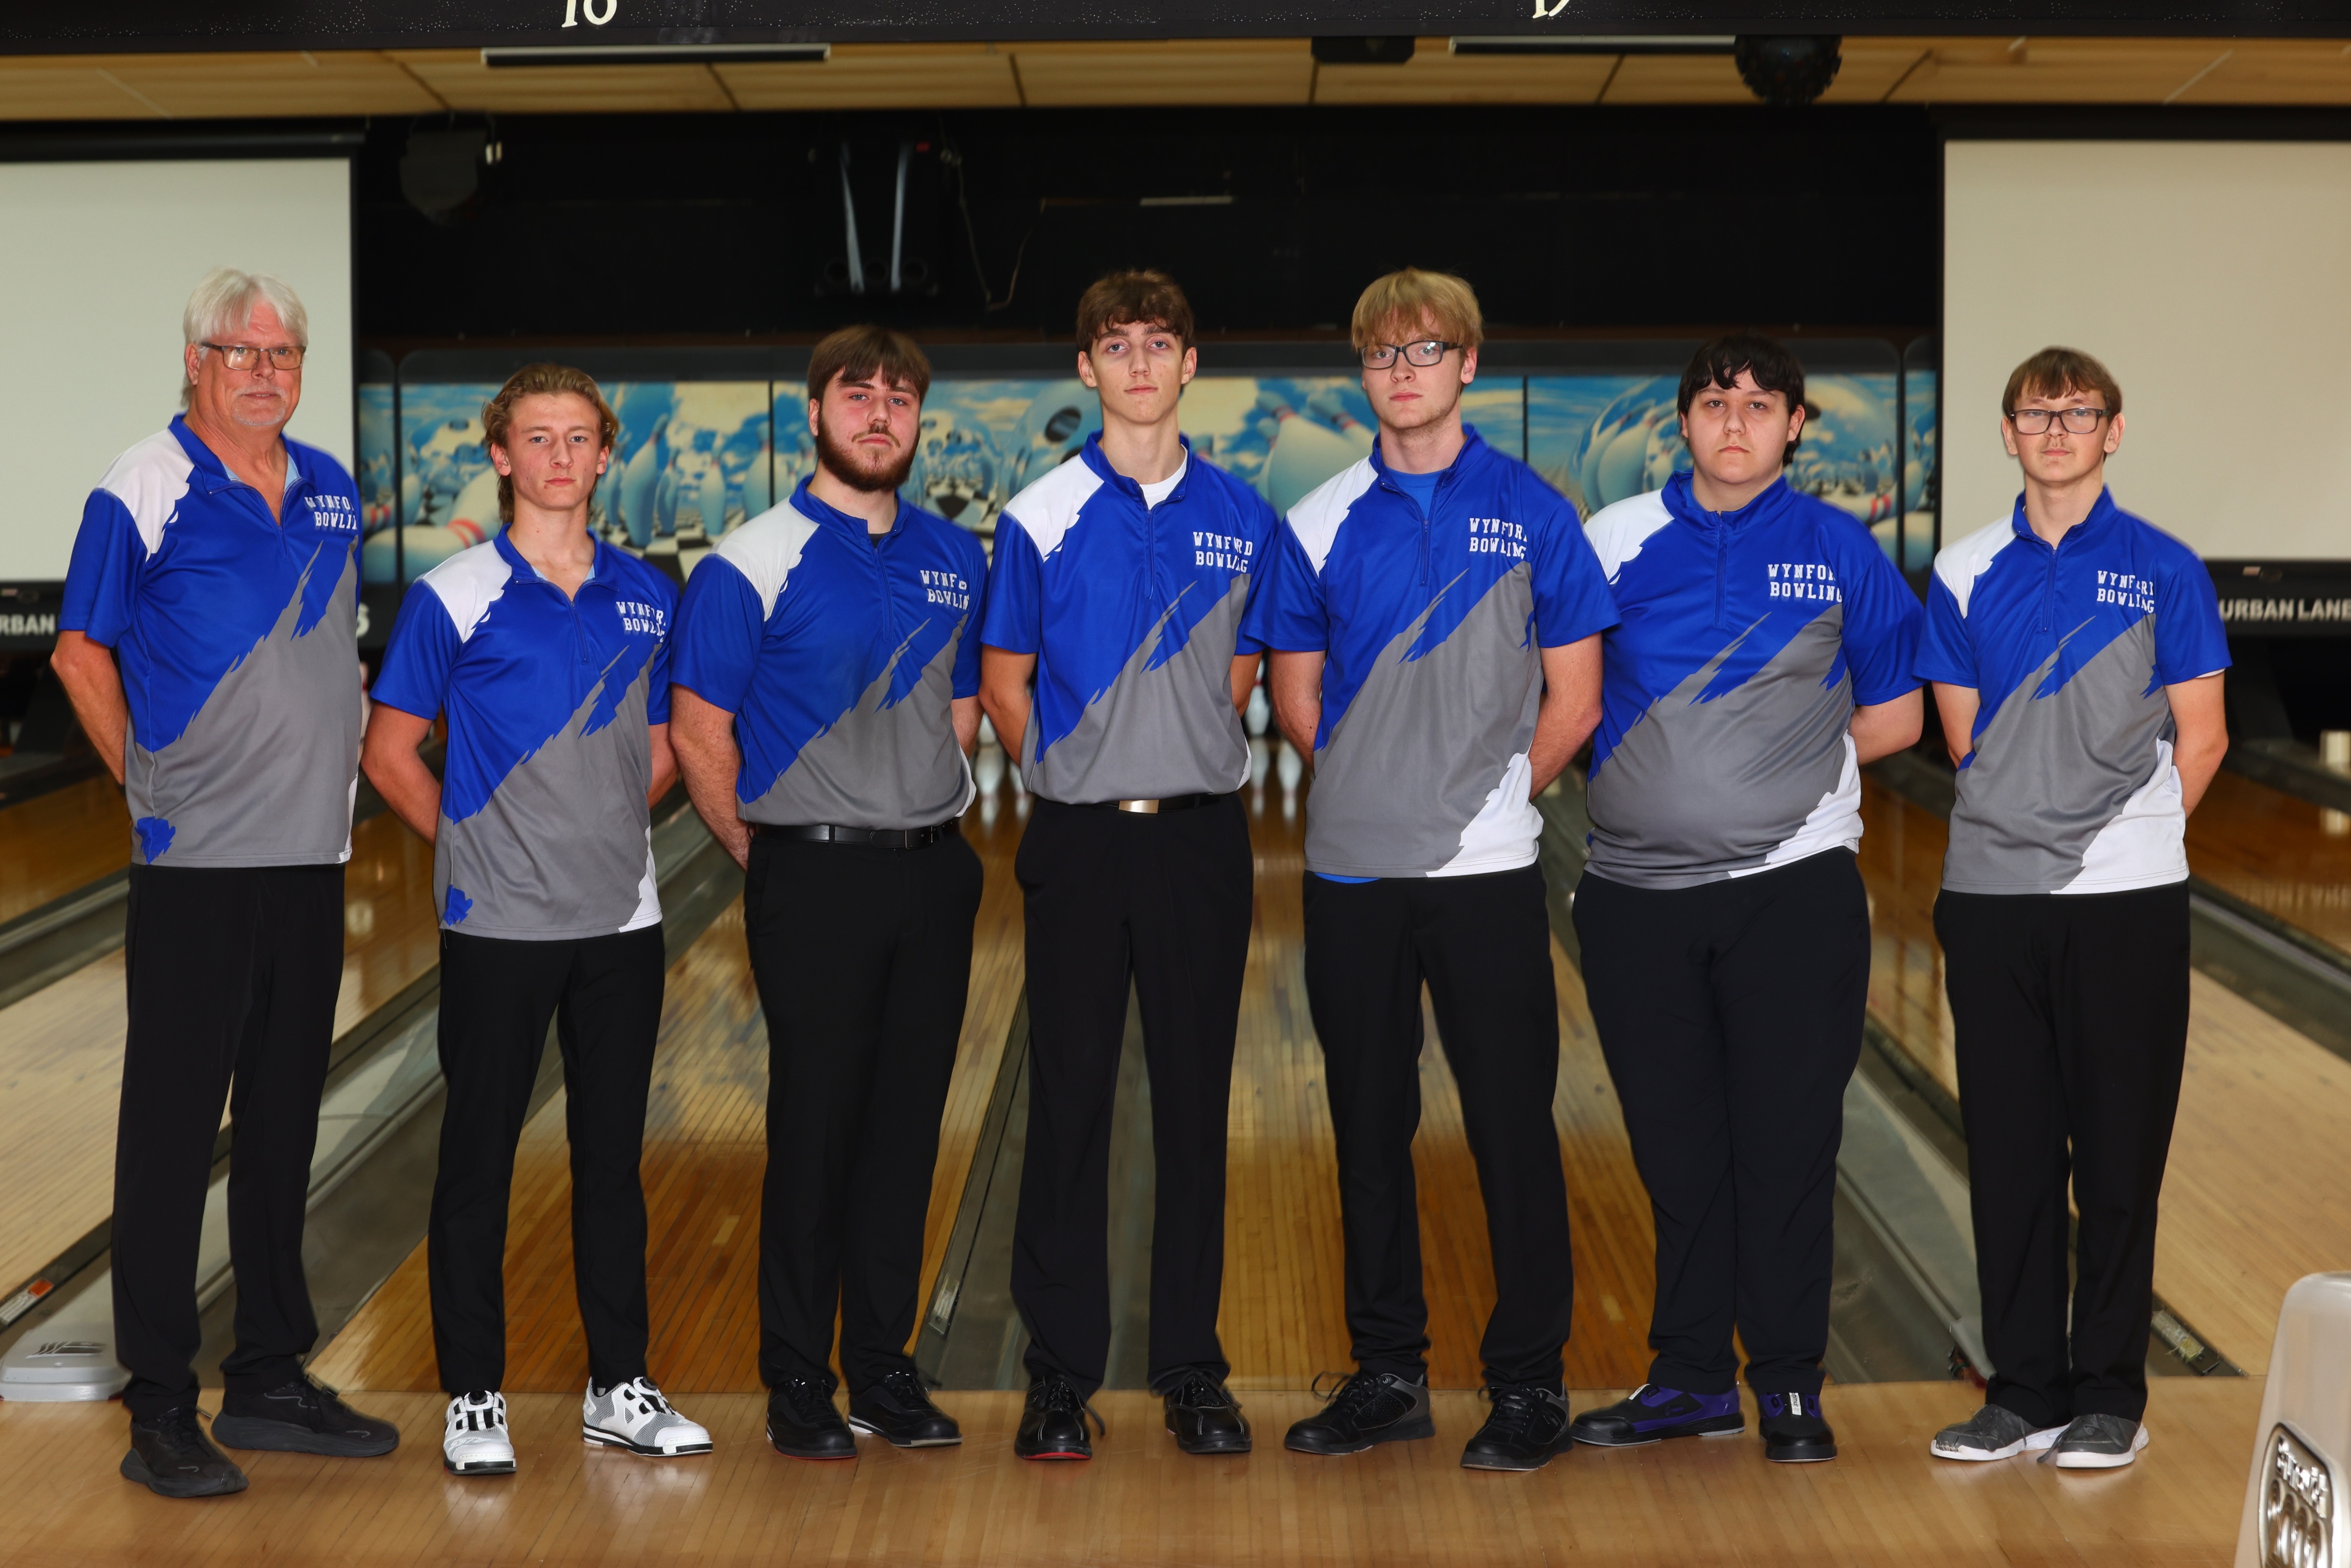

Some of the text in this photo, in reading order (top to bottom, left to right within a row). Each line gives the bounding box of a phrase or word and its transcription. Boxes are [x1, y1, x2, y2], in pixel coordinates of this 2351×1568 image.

[304, 495, 354, 511] WYNFO
[927, 588, 969, 611] BOWLIN
[2219, 598, 2295, 622] URBAN
[616, 602, 666, 626] WYNFR
